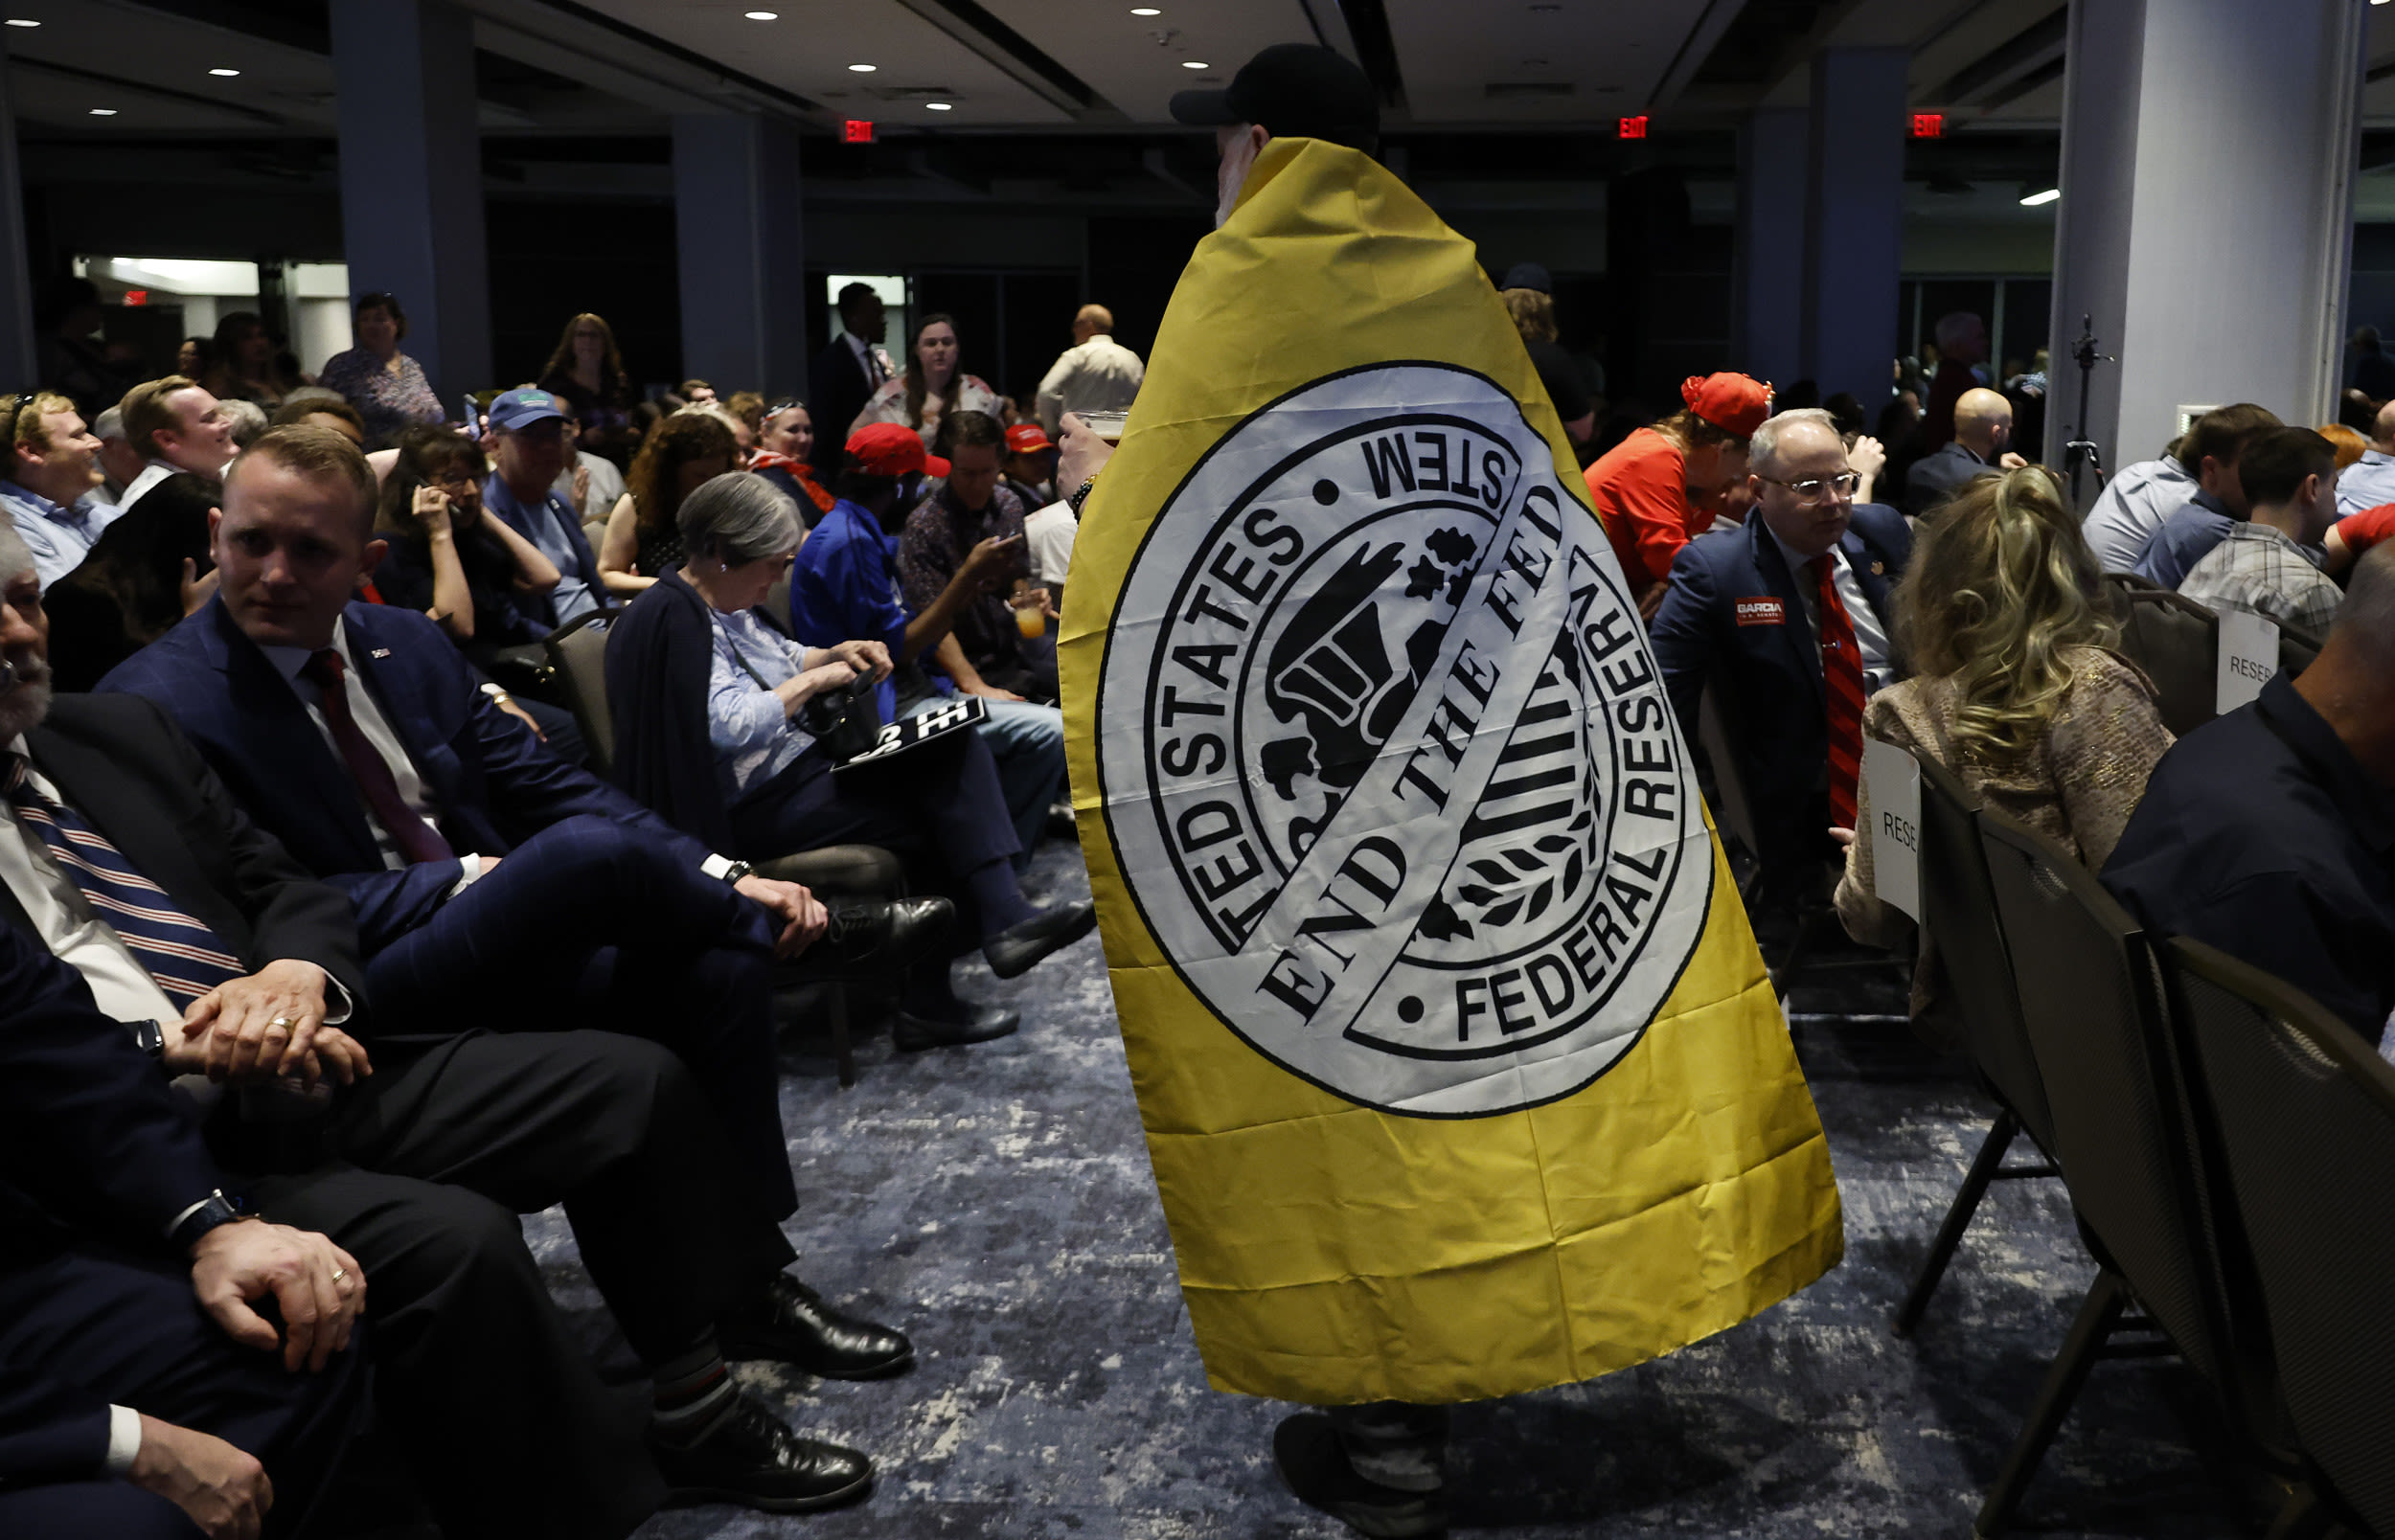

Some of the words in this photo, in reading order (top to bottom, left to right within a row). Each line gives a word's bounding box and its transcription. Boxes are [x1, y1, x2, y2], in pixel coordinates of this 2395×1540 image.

[1161, 509, 1304, 777] STATES
[1737, 602, 1783, 613] GARCIA
[1256, 836, 1406, 1027] END
[1392, 639, 1500, 816] THE
[1482, 486, 1562, 642] FED
[1456, 849, 1667, 1041] FEDERAL
[1569, 559, 1675, 821] RESERV
[1883, 811, 1917, 852] RESE
